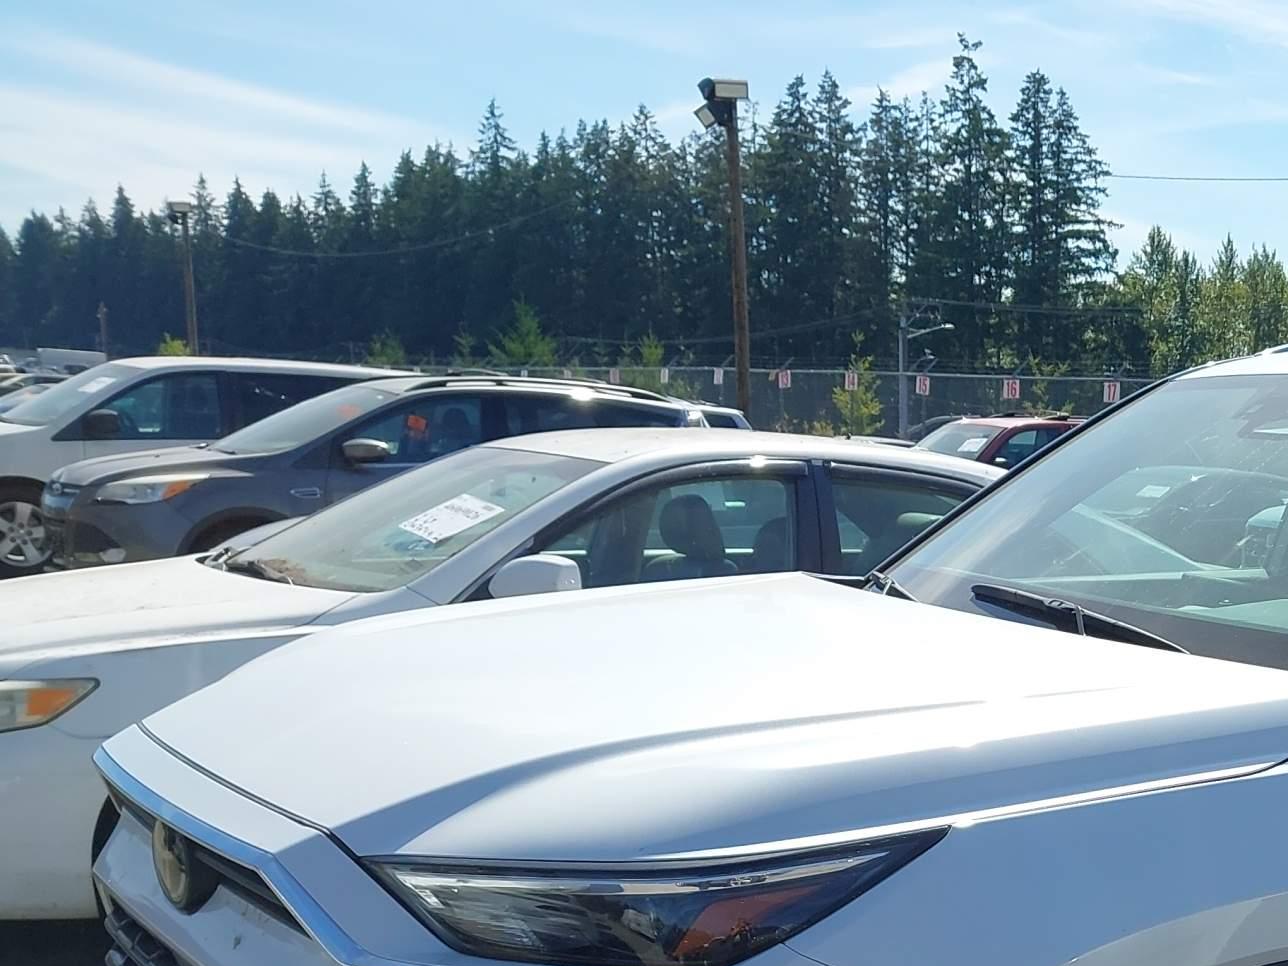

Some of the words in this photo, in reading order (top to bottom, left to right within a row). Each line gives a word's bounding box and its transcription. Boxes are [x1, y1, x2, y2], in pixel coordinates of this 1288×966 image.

[919, 378, 928, 394] 15
[1006, 381, 1017, 397] 16
[1107, 383, 1117, 401] 17
